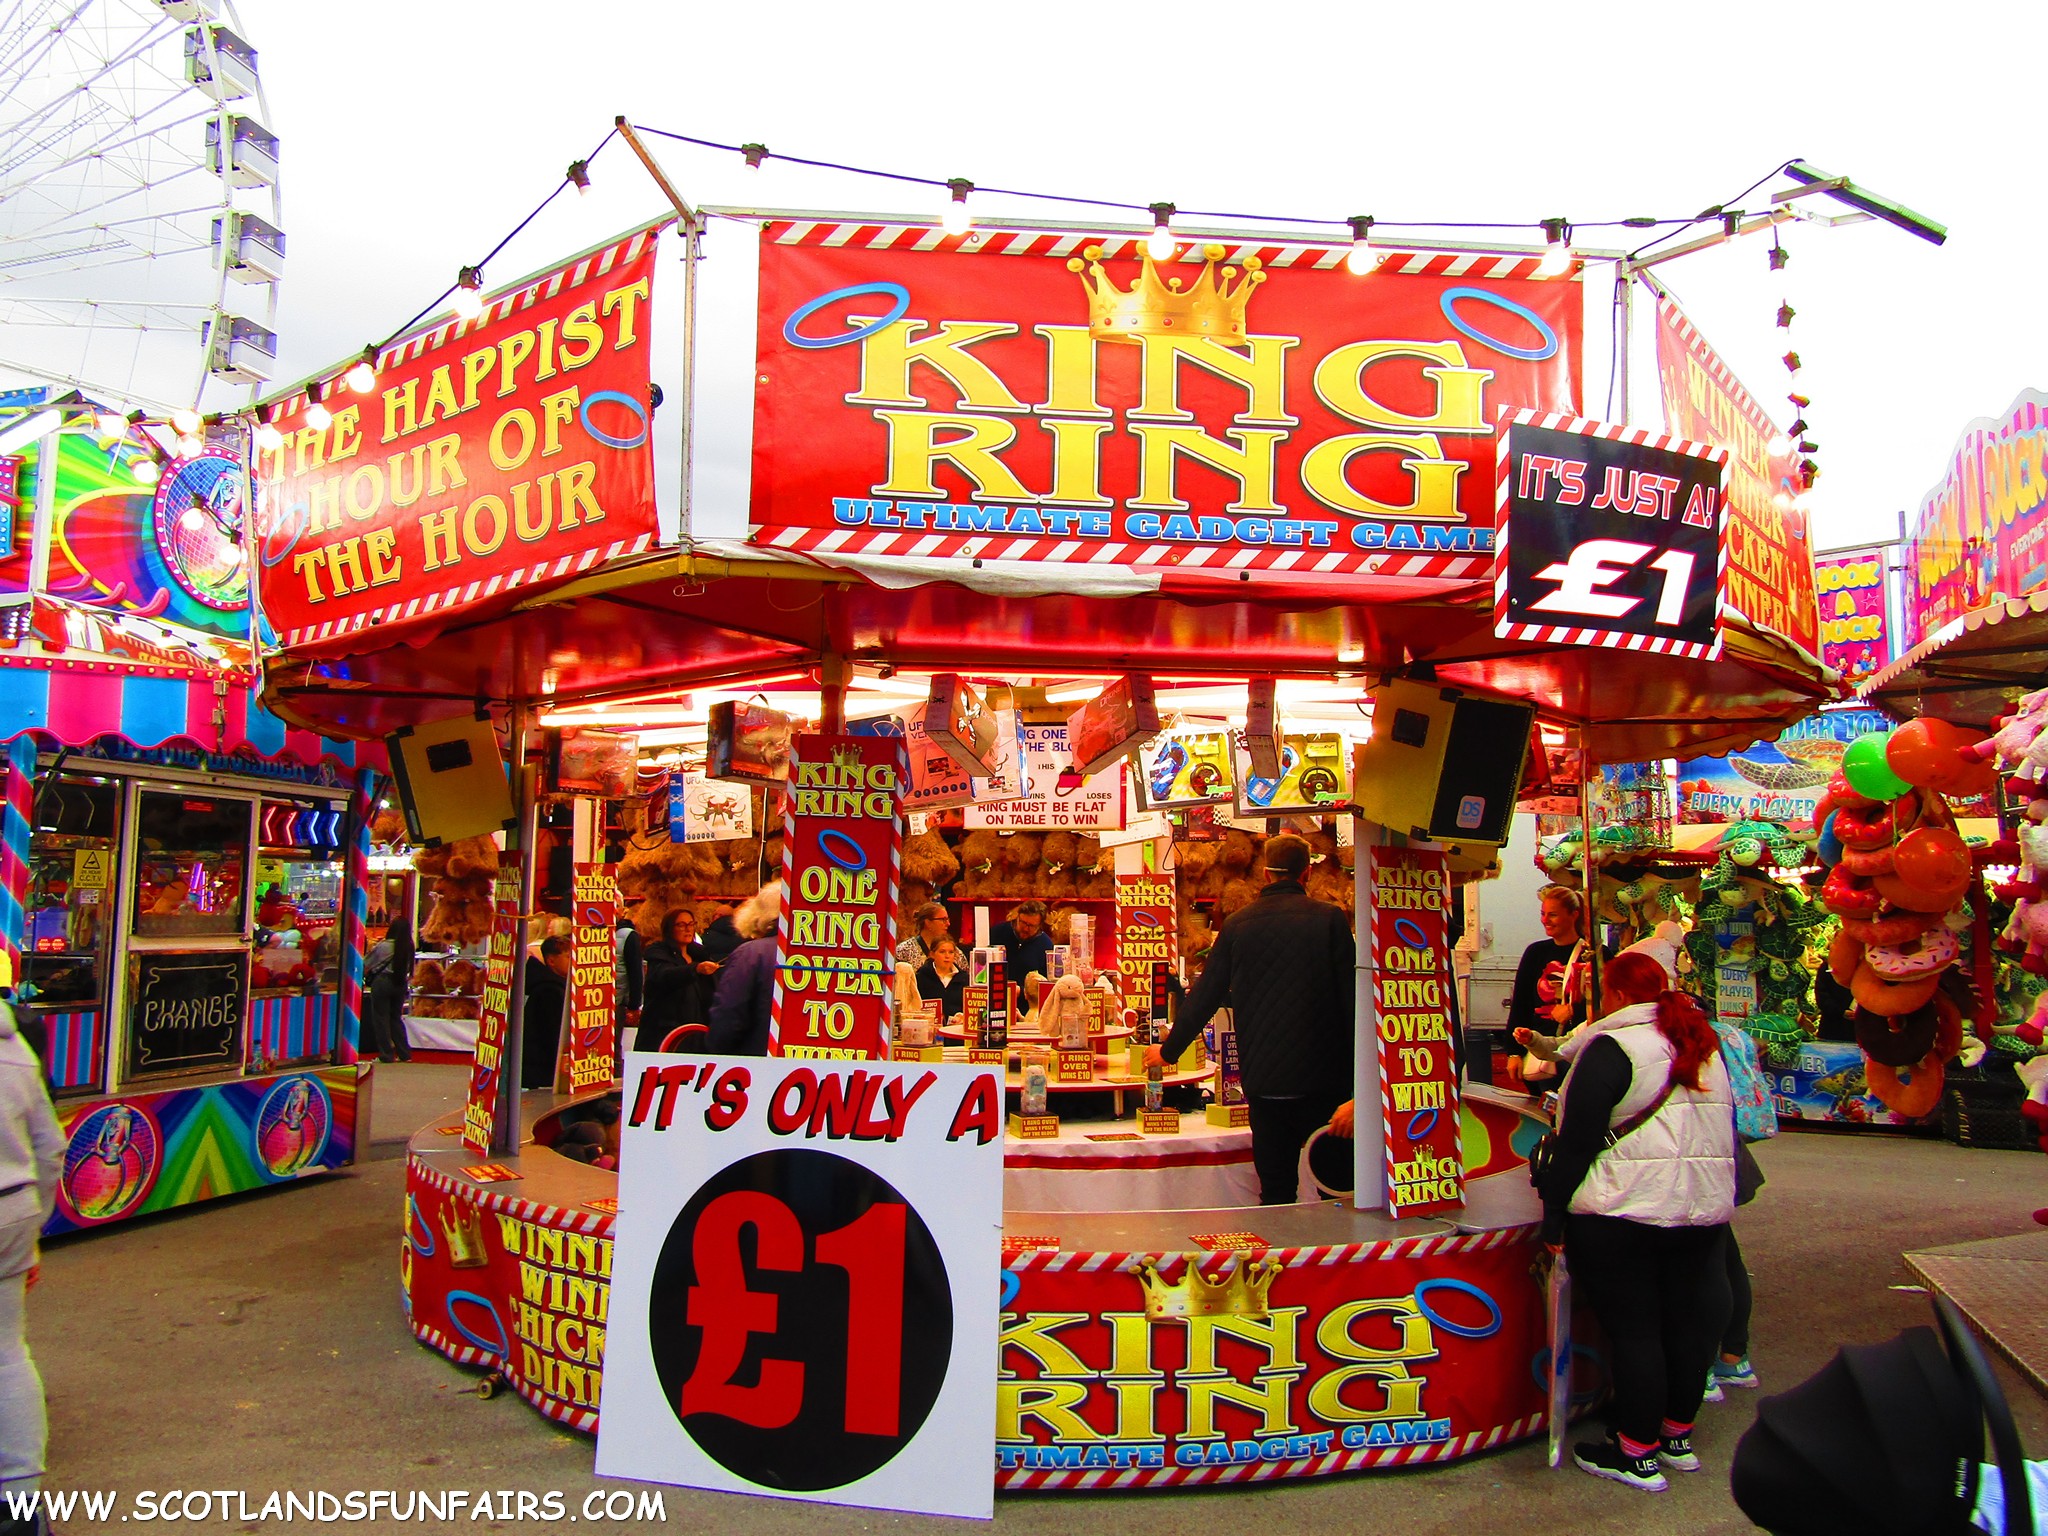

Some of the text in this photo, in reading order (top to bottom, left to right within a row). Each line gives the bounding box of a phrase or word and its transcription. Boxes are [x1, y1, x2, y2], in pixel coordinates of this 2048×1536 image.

[262, 276, 649, 486] THE HAPPIST
[844, 314, 1495, 435] KING
[1686, 351, 1773, 489] WINNER
[307, 385, 580, 536] HOUR OF
[870, 408, 1470, 522] RING
[1518, 452, 1588, 506] IT'S
[1590, 465, 1681, 521] JUST
[1680, 482, 1716, 530] A!
[294, 460, 606, 604] THE HOUR
[832, 497, 1498, 553] ULTIMATE GADGET GAME
[1727, 513, 1784, 595] CKEN
[1525, 537, 1697, 627] £1
[1727, 565, 1793, 638] NNER!
[1835, 589, 1857, 617] A
[1025, 742, 1045, 752] HE
[1041, 729, 1067, 740] ONE
[796, 761, 897, 791] KING
[795, 789, 893, 819] RING
[978, 802, 1106, 812] RING MUST BE FLAT
[1086, 792, 1112, 800] LOSES
[1462, 801, 1481, 817] DS
[1691, 791, 1816, 818] EVERY PLAYER
[985, 815, 1098, 825] ON TABLE TO WIN
[577, 875, 615, 889] KING
[800, 866, 879, 905] ONE
[1120, 884, 1170, 896] KING
[1377, 866, 1442, 889] KING
[576, 888, 615, 903] RING
[1120, 895, 1170, 907] RING
[1378, 887, 1442, 911] RING
[580, 926, 609, 943] ONE
[791, 910, 880, 950] RING
[1125, 925, 1166, 941] ONE
[493, 932, 512, 956] ONE
[577, 945, 610, 964] RING
[1123, 942, 1168, 958] RING
[488, 960, 509, 984] RING
[1385, 946, 1437, 974] ONE
[575, 967, 612, 986] OVER
[782, 954, 884, 996] OVER
[484, 987, 508, 1015] OVER
[583, 988, 603, 1007] TO
[1382, 979, 1440, 1009] RING
[1719, 985, 1753, 998] PLAYER
[144, 994, 238, 1034] CHANGE
[577, 1007, 608, 1029] WIN!
[803, 1000, 855, 1040] TO
[1089, 1017, 1100, 1031] 20
[485, 1016, 498, 1041] TO
[1382, 1013, 1449, 1043] OVER
[477, 1044, 499, 1070] WIN!
[573, 1056, 610, 1073] KING
[1399, 1047, 1434, 1078] TO
[573, 1070, 610, 1087] RING
[1078, 1071, 1090, 1080] £10
[1780, 1075, 1796, 1094] A
[628, 1062, 1000, 1146] IT'S ONLY A
[1392, 1081, 1446, 1112] WIN!
[466, 1103, 491, 1128] KING
[464, 1122, 488, 1148] RING
[1394, 1156, 1458, 1183] KING
[1395, 1180, 1459, 1208] RING
[680, 1190, 907, 1438] £1
[508, 1294, 607, 1366] CHICK
[998, 1293, 1440, 1379] KING
[996, 1361, 1428, 1444] RING
[997, 1417, 1452, 1469] TIMATE GADGET GAME
